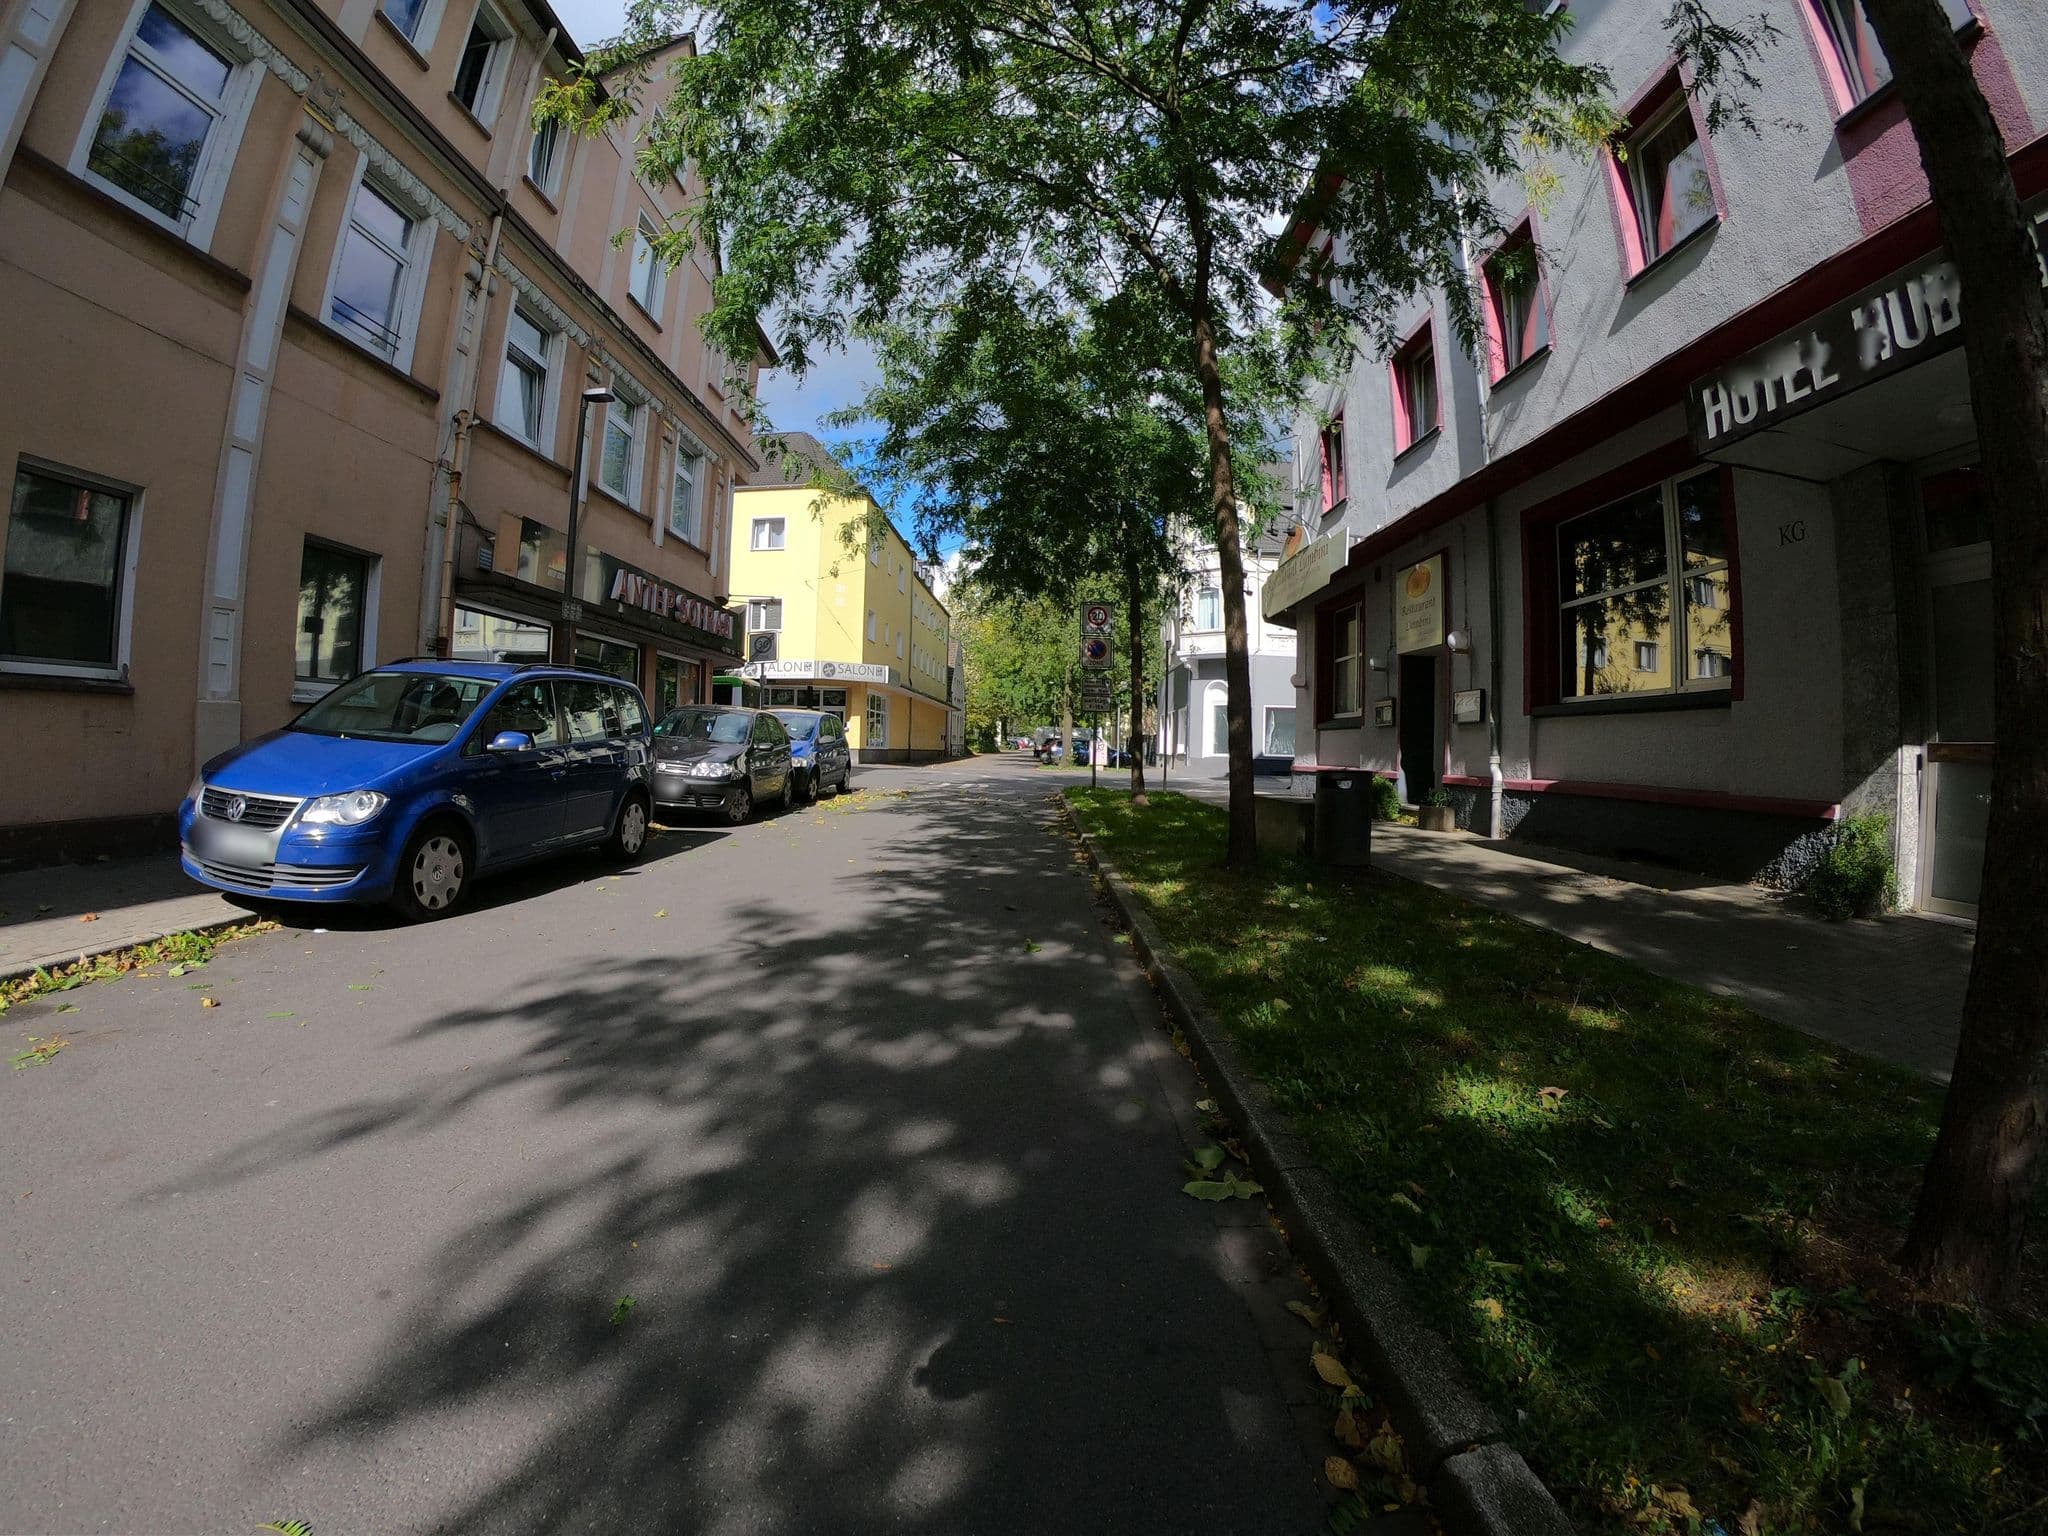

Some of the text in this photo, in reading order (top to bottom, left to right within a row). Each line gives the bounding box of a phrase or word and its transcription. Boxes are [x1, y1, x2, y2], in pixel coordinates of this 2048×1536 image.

[1702, 331, 1839, 439] HOTEL
[1778, 521, 1807, 547] KG
[610, 568, 675, 617] ANTEP
[758, 640, 769, 649] 30
[838, 663, 875, 676] SALON
